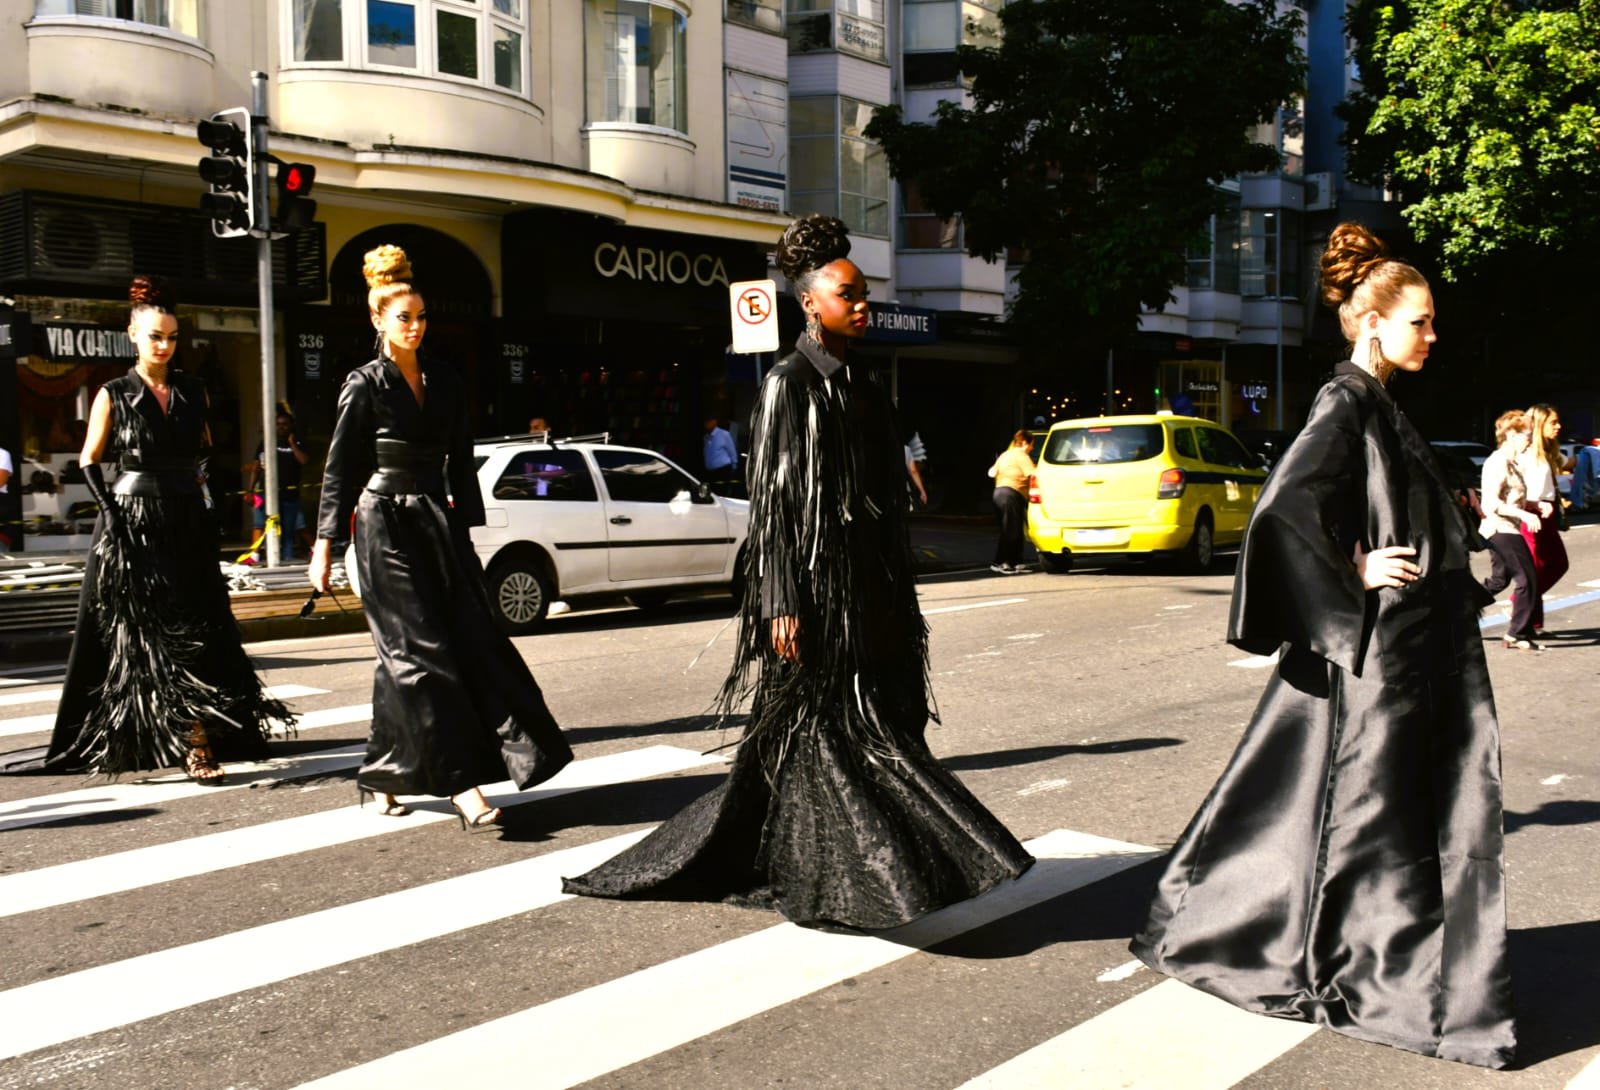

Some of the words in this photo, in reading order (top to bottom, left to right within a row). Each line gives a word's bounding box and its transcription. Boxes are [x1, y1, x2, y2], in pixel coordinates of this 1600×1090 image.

[594, 241, 730, 288] CARIOCA
[748, 295, 761, 317] E
[876, 312, 929, 333] PIEMONTE
[46, 327, 75, 358] VIA
[298, 333, 325, 349] 336
[1241, 384, 1269, 400] LUPO
